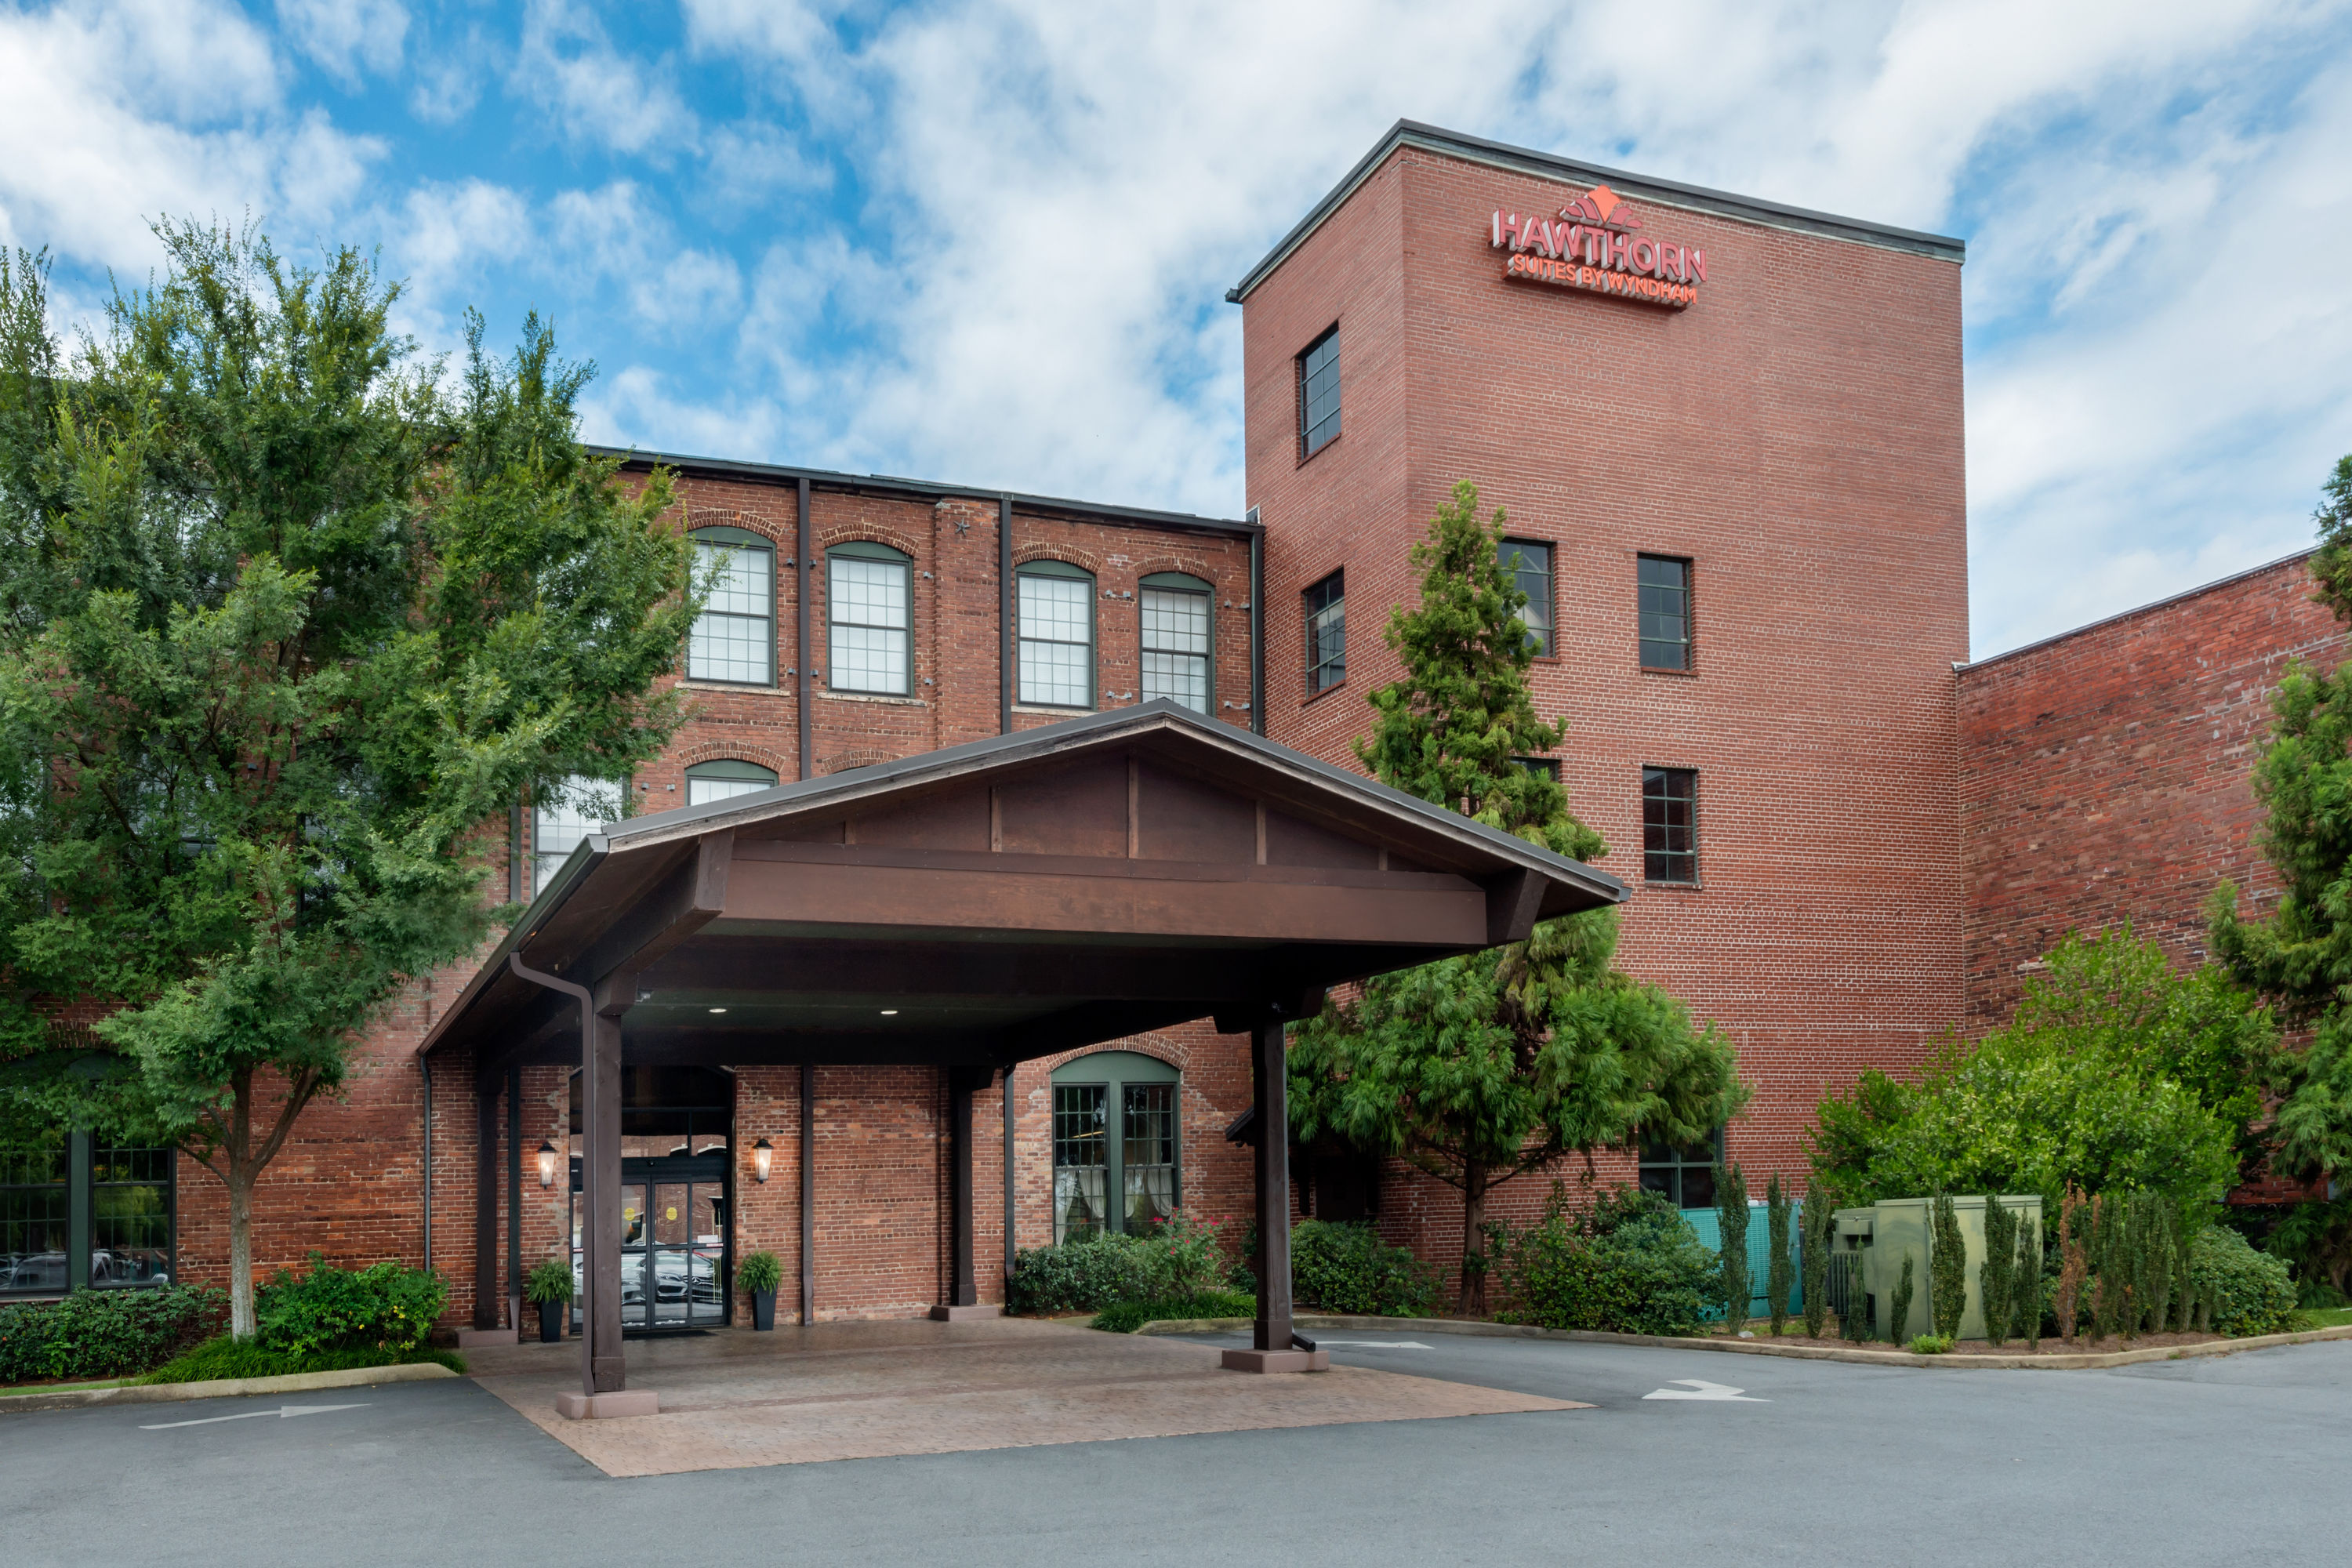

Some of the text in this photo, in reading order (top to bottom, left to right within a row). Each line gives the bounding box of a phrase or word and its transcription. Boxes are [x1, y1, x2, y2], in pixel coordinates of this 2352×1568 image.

[1495, 209, 1707, 282] HAWTHORN
[1513, 253, 1697, 304] SUITES BY WYNDHAM
